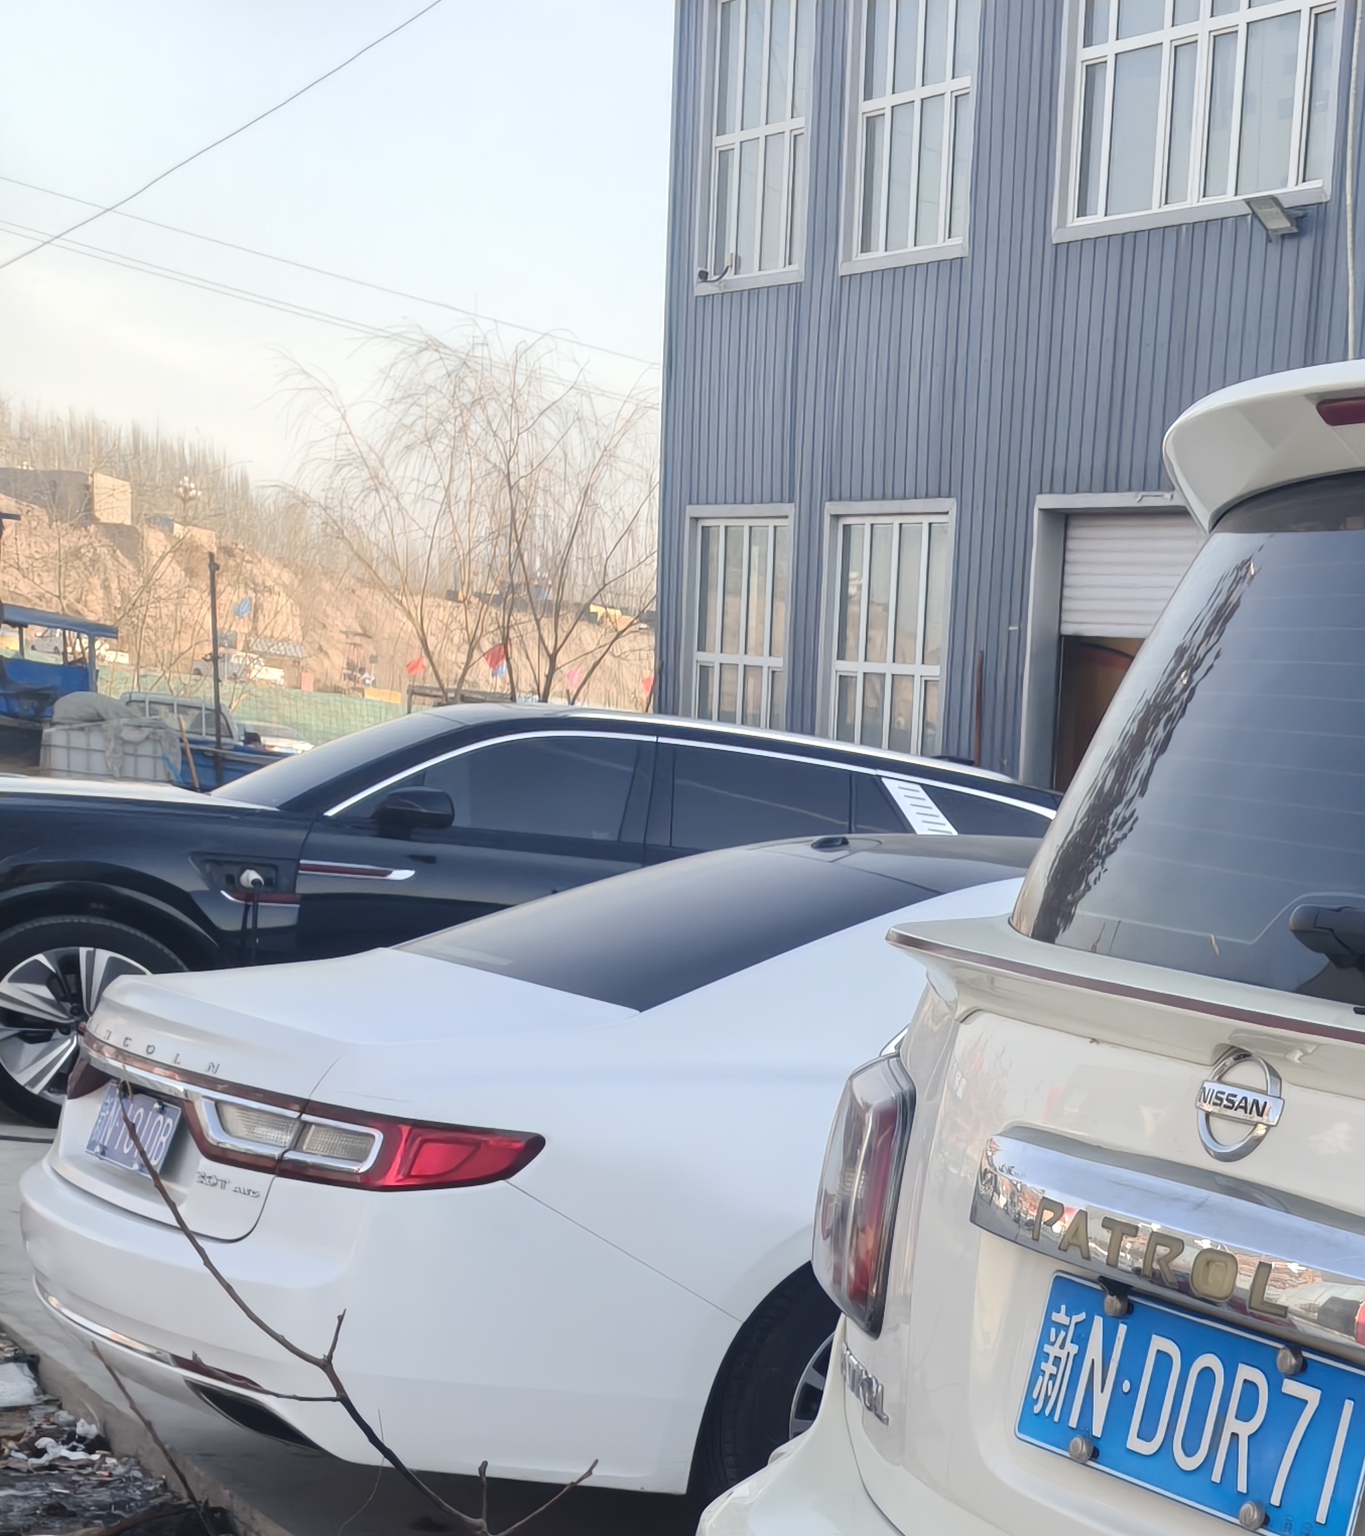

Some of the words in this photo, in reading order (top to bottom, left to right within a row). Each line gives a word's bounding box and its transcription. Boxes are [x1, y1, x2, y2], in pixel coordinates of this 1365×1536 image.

[93, 1096, 175, 1166] N·1010B
[1199, 1086, 1268, 1118] NISSAN
[1031, 1196, 1290, 1318] PATROL
[1032, 1303, 1355, 1525] 新N·D0R71
